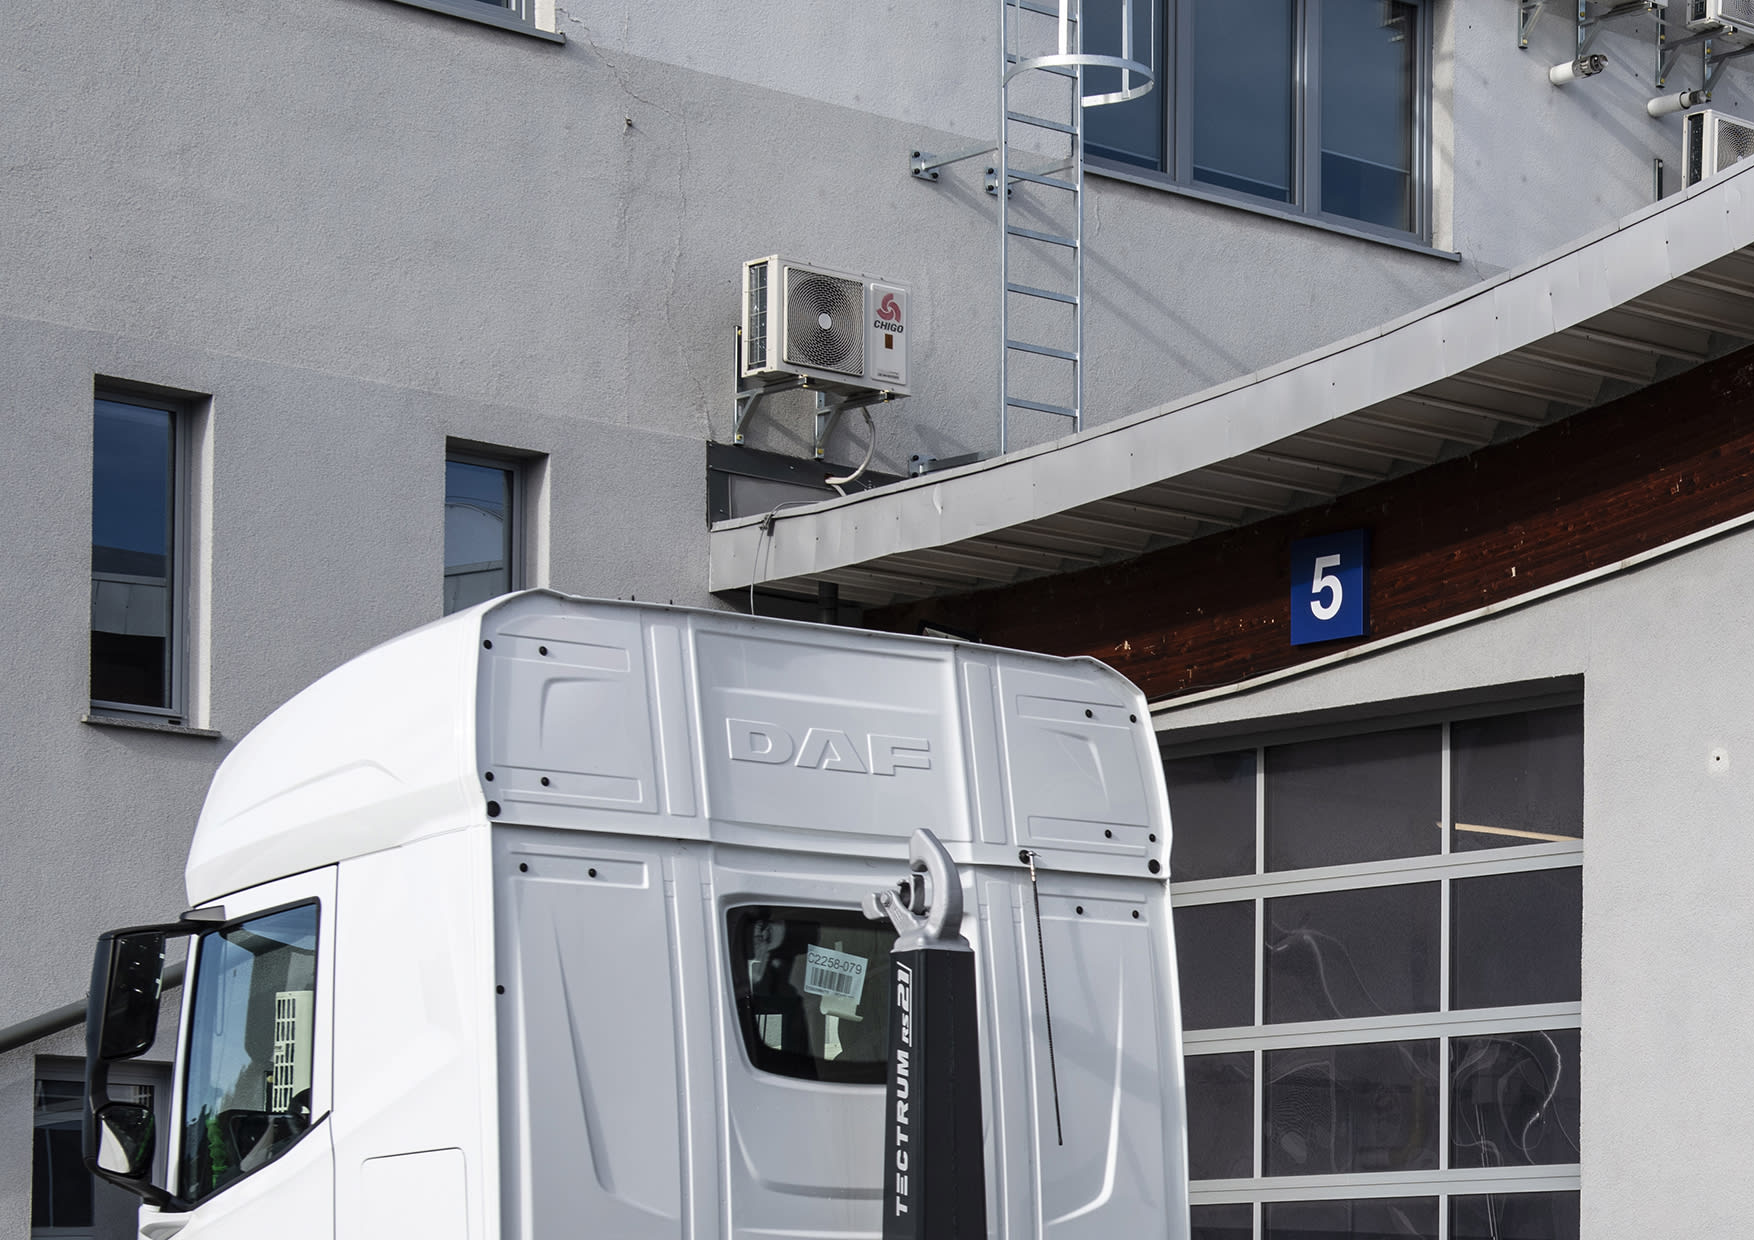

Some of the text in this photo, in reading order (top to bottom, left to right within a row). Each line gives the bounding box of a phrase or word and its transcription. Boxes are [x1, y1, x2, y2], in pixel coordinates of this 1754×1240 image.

[873, 320, 904, 333] CHIGO
[1310, 553, 1343, 621] 5
[725, 717, 931, 776] DAF
[808, 951, 863, 975] C2258-079
[896, 1050, 910, 1217] TECTRUM
